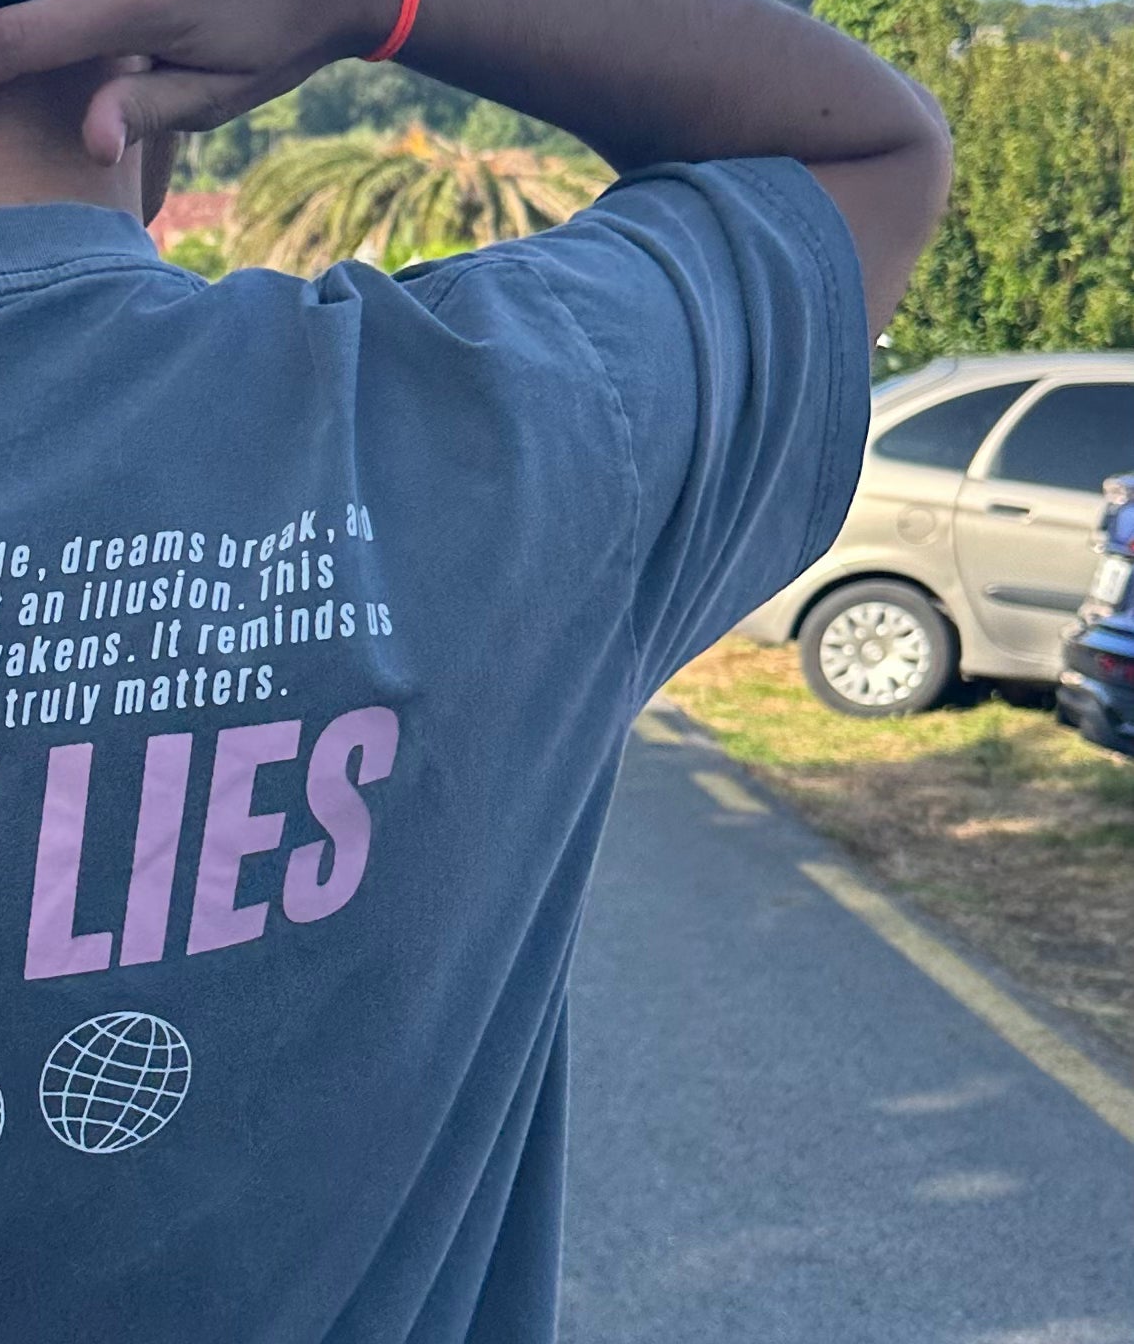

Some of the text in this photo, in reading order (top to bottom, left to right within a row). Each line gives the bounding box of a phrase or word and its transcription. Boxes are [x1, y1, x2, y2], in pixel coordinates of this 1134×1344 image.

[60, 529, 206, 575] dreams
[217, 509, 335, 570] break,
[17, 591, 65, 629] an
[79, 568, 245, 622] illusion.
[259, 550, 335, 602] This
[150, 618, 182, 660] It
[197, 599, 356, 655] reminds
[365, 602, 393, 637] us
[4, 679, 101, 730] truly
[113, 663, 288, 716] matters.
[23, 705, 400, 981] LIES
